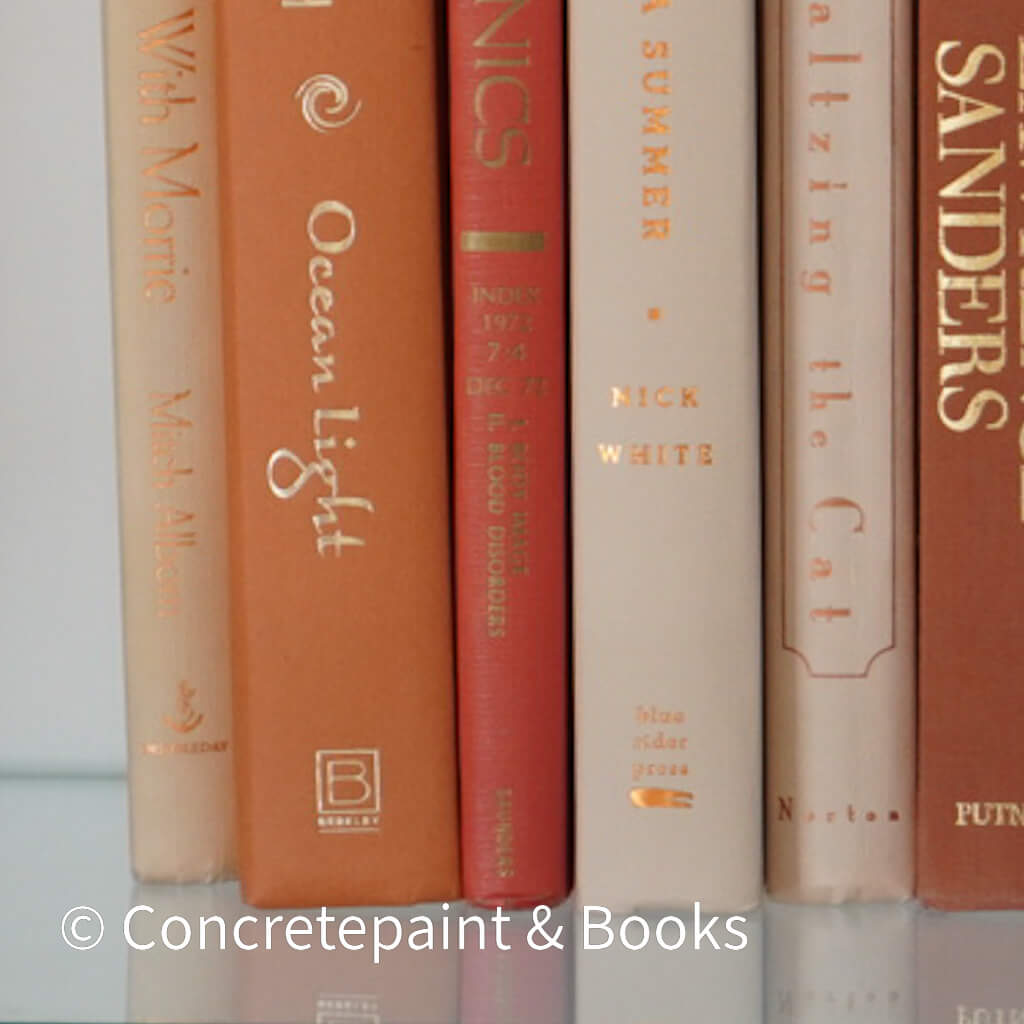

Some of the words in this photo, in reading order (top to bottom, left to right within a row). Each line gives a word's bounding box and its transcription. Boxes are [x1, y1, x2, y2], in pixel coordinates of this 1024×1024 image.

[136, 7, 197, 127] With
[641, 40, 673, 241] SUMMER
[141, 143, 200, 306] Morrie
[935, 39, 1009, 433] SANDERS
[306, 199, 356, 393] Ocean
[148, 389, 195, 489] Mitch
[597, 443, 714, 466] WHITE
[610, 386, 702, 409] NICK
[808, 359, 854, 449] the
[266, 404, 375, 557] Light
[154, 506, 197, 617] Albom
[486, 525, 506, 638] DISORDERS
[809, 496, 864, 622] Cat
[326, 759, 372, 806] B
